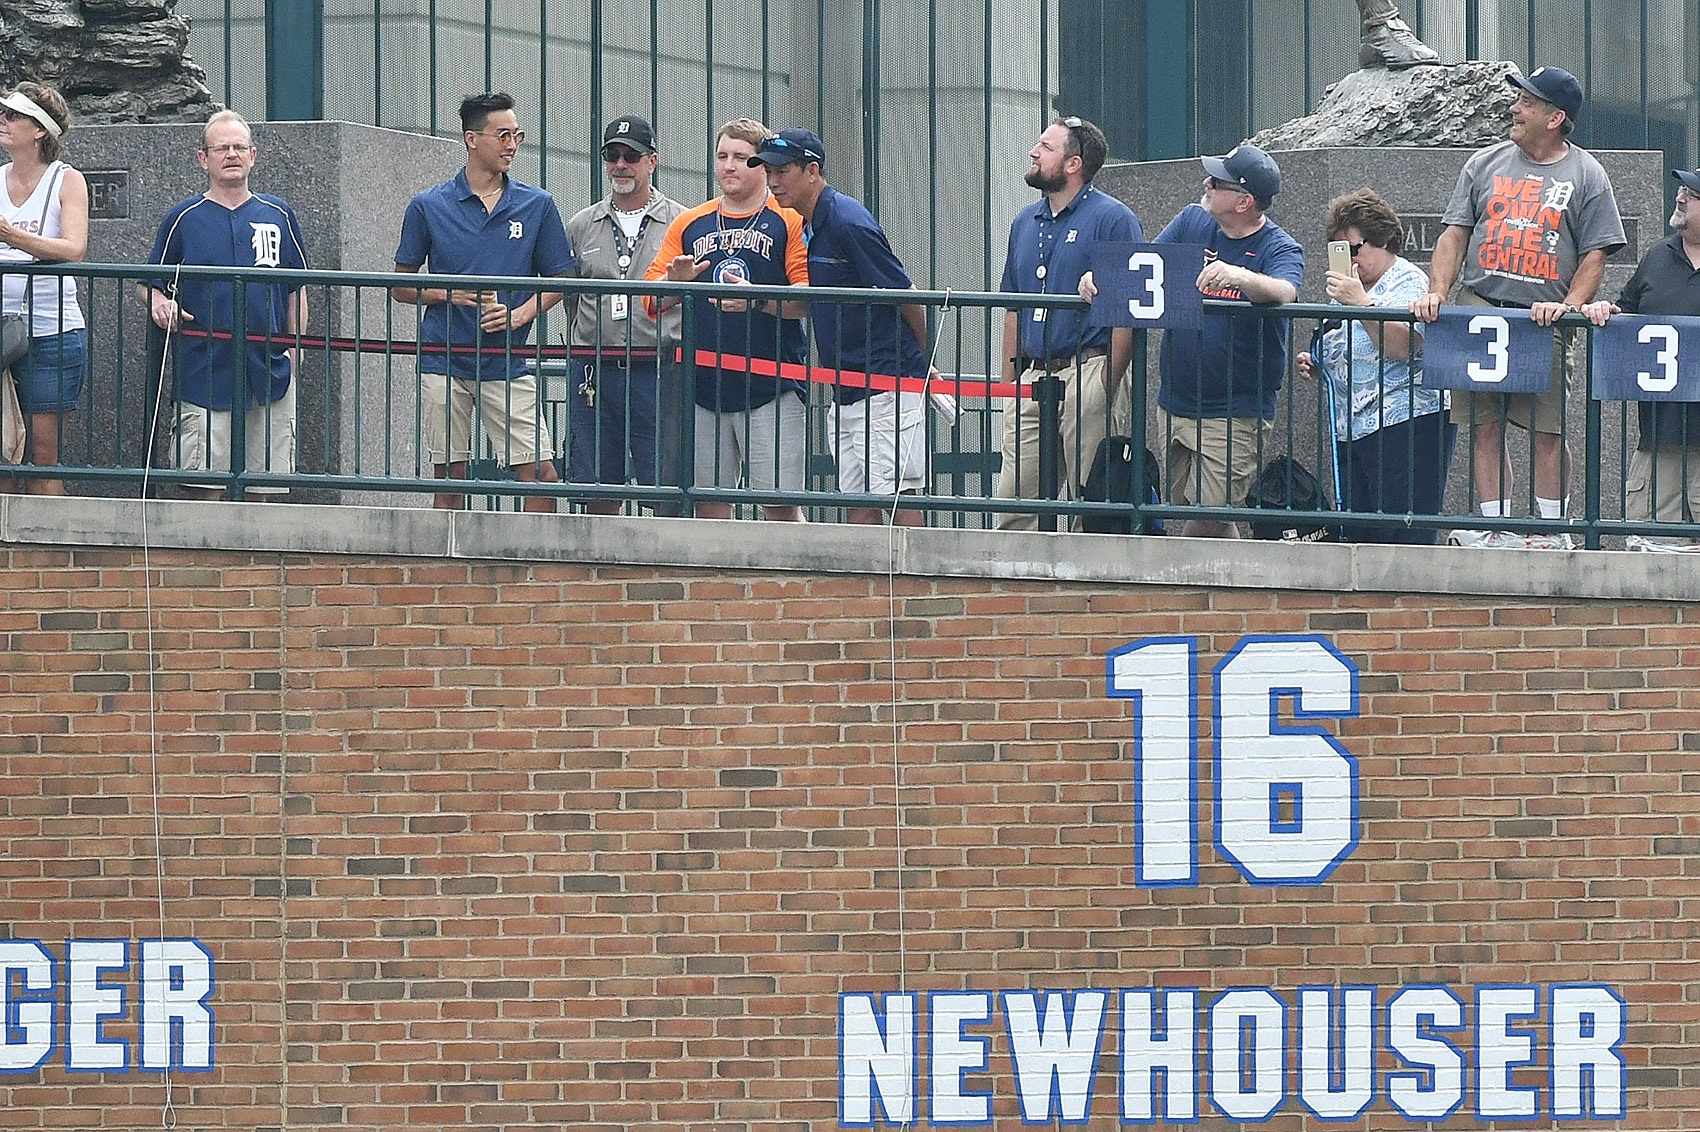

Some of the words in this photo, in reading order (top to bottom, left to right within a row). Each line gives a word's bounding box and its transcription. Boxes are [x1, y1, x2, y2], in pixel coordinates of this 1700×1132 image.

[1487, 196, 1562, 230] OWN
[1493, 175, 1545, 202] WE
[693, 228, 774, 264] DETROIT
[1484, 218, 1545, 252] THE
[1128, 252, 1165, 320] 3
[1478, 243, 1560, 281] CENTRAL
[1467, 315, 1510, 382] 3
[1637, 324, 1679, 392] 3
[1106, 634, 1360, 888] 16
[838, 982, 1628, 1128] NEWHOUSER
